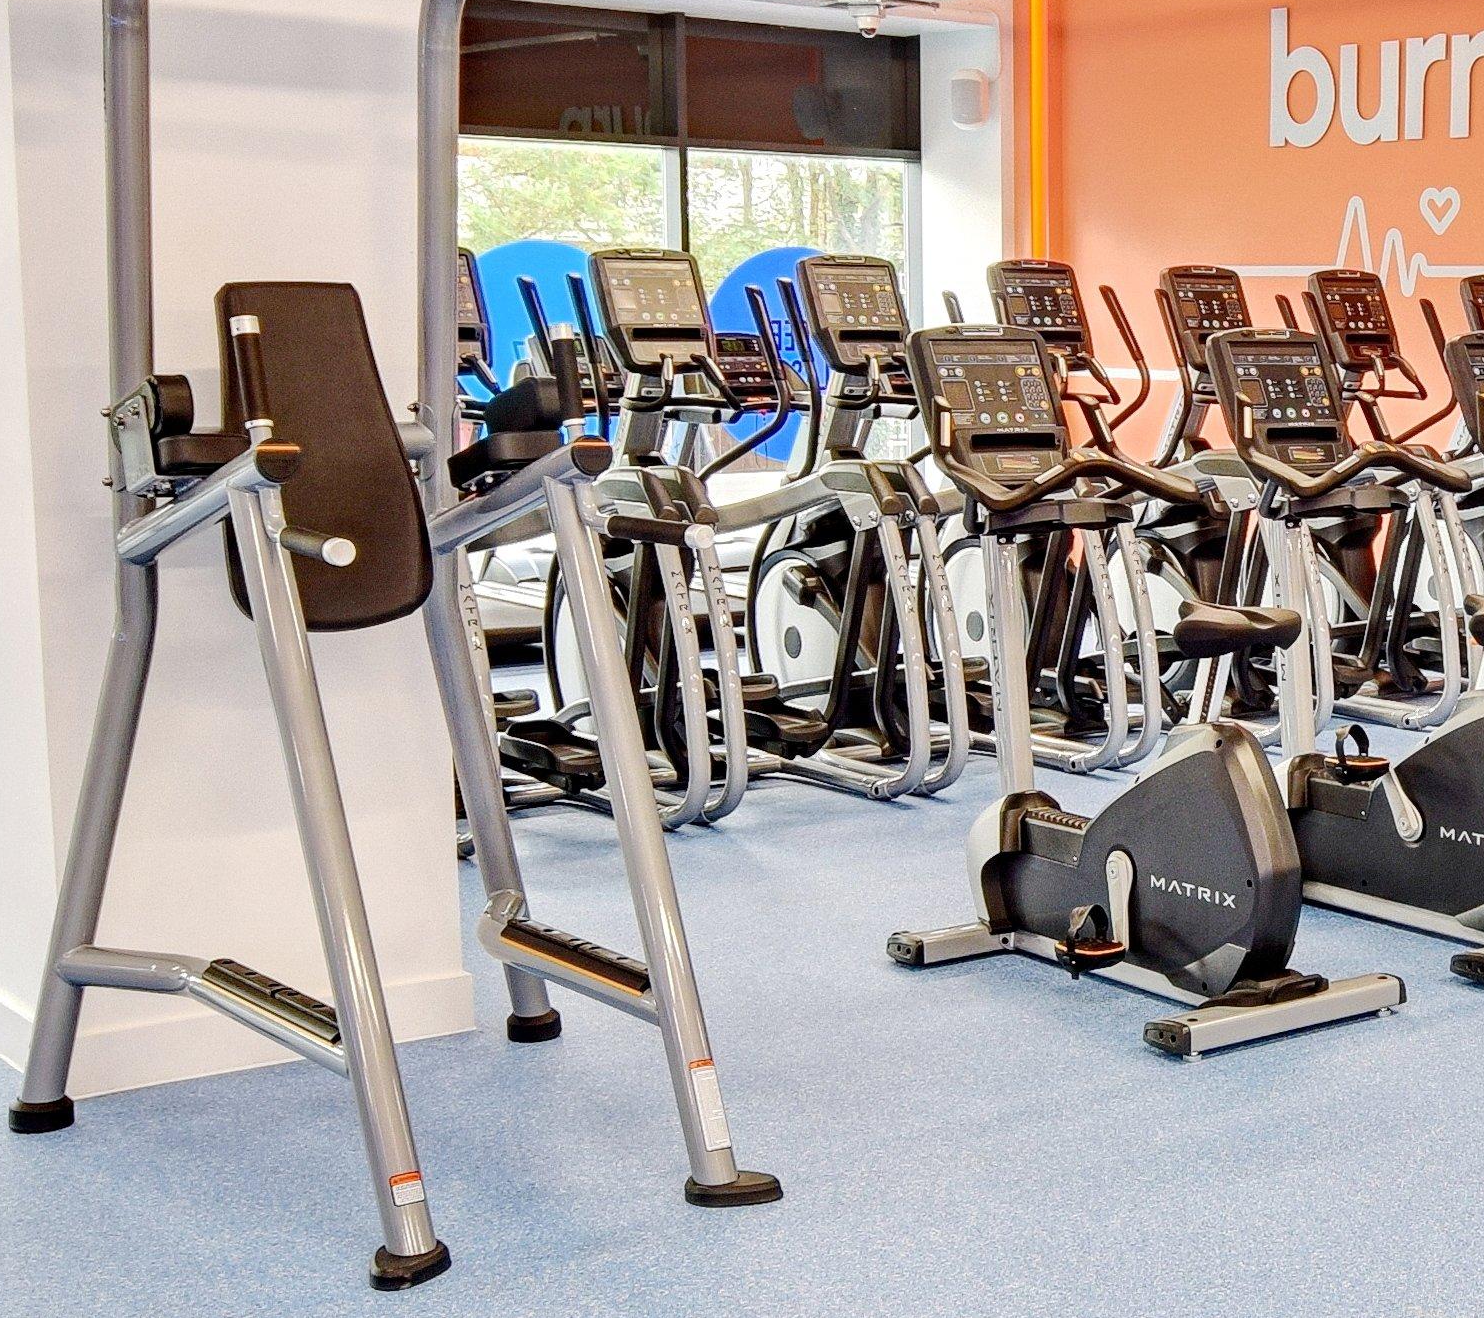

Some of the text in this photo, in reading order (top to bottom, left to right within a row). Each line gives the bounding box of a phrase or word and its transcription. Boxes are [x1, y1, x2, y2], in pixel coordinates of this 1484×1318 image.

[670, 570, 693, 634] MATRX
[932, 553, 954, 612] MATRX
[1150, 873, 1237, 910] MATRIX
